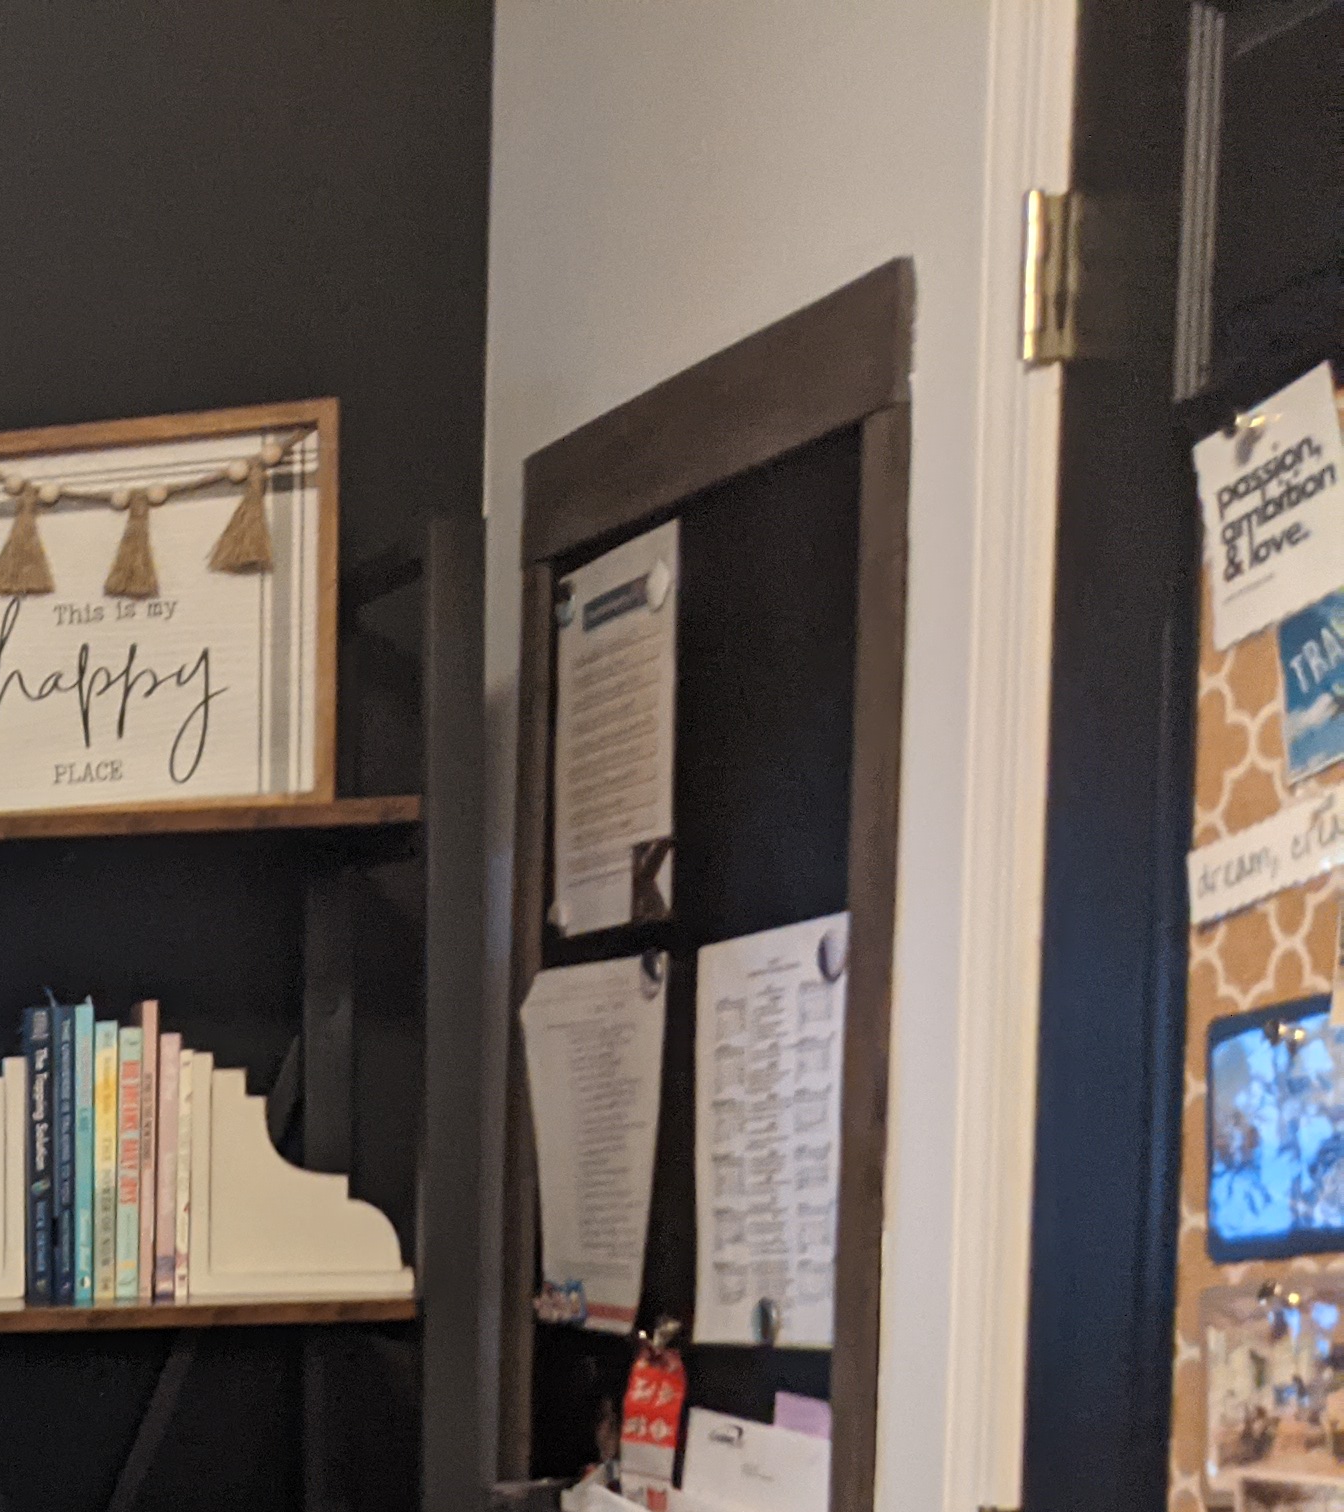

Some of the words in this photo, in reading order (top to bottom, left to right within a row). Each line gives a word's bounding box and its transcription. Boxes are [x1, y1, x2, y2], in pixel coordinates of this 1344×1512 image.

[1217, 436, 1322, 519] passion,
[1223, 464, 1337, 545] ambition
[1223, 543, 1244, 583] &
[53, 601, 104, 626] This
[115, 599, 136, 620] is
[147, 599, 178, 621] my
[52, 760, 124, 785] PLACE
[34, 1046, 49, 1071] The
